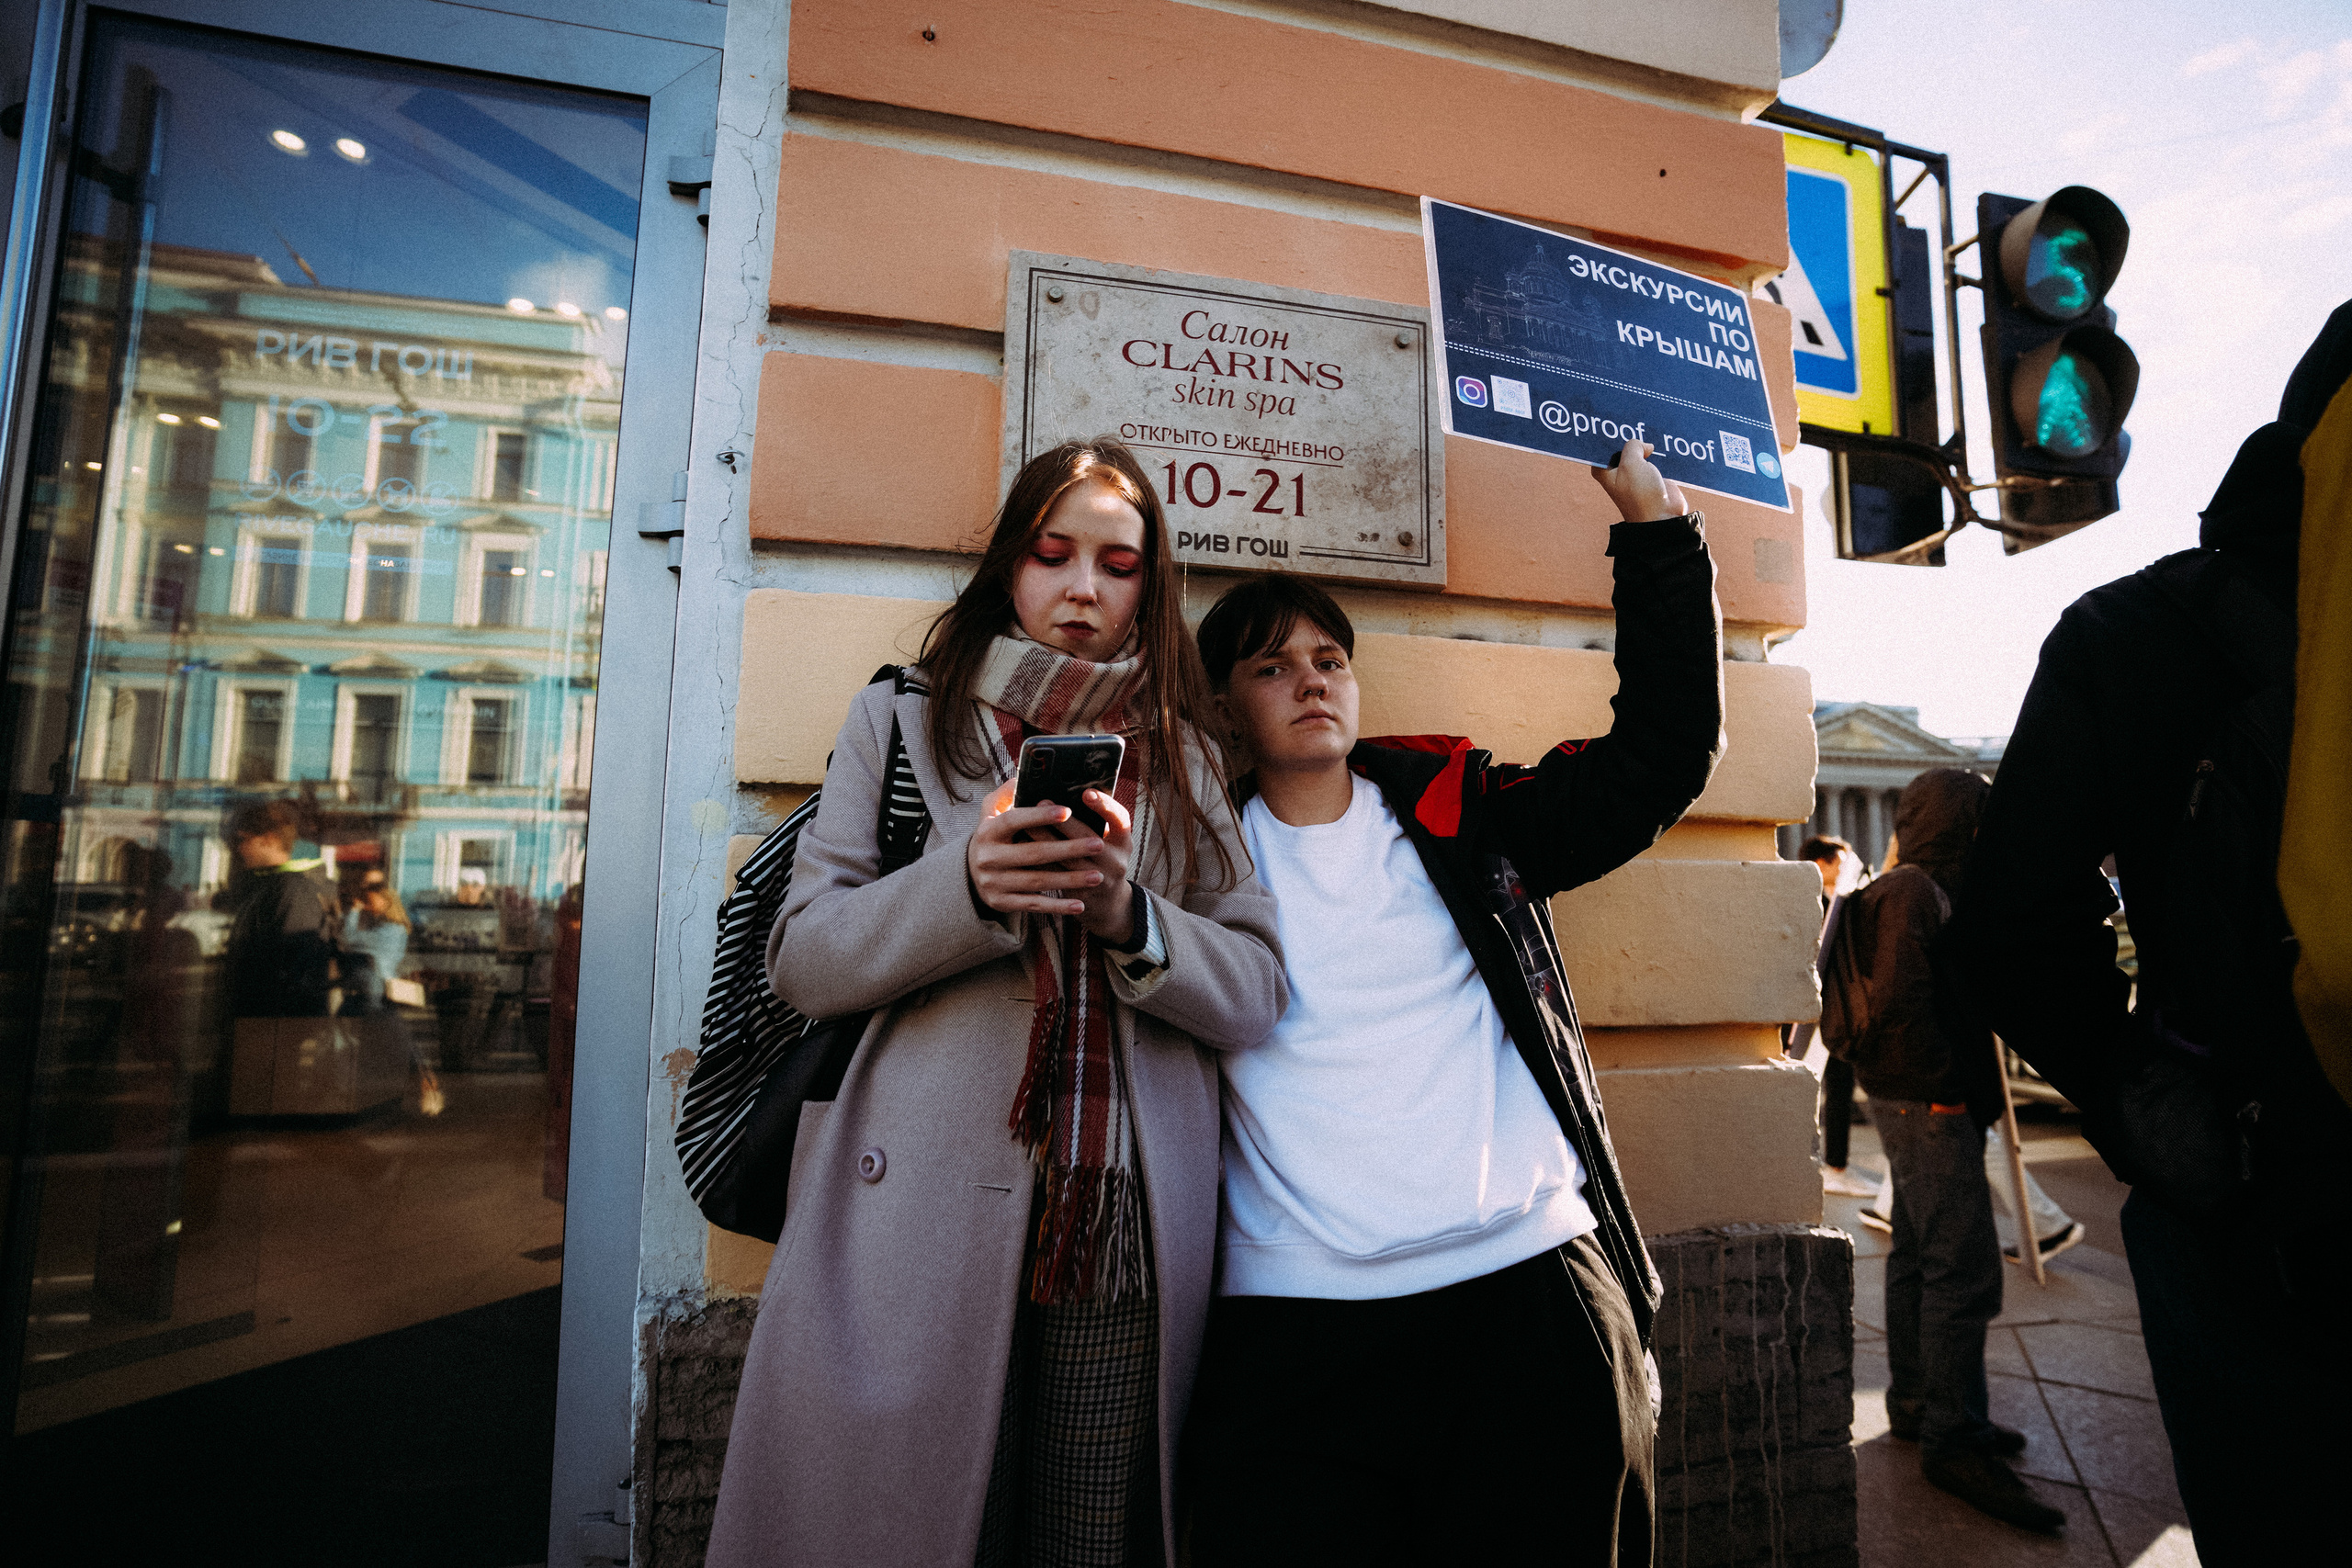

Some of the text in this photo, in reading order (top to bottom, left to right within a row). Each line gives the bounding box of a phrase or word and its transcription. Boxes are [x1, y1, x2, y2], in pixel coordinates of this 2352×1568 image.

[1568, 254, 1746, 326] ЭКСКУРСИИ
[256, 328, 474, 381] РИВ ГОШ
[1180, 310, 1290, 352] Салон
[1615, 320, 1758, 382] КРЫШАМ
[1708, 321, 1751, 353] ПО
[1121, 338, 1345, 390] CLARINS
[1171, 376, 1297, 420] skin spa
[1120, 423, 1345, 463] ОТКРЫТО ЕЖЕДНЕВНО
[1160, 459, 1306, 517] 10-21
[1177, 531, 1288, 558] РИВ ГОШ
